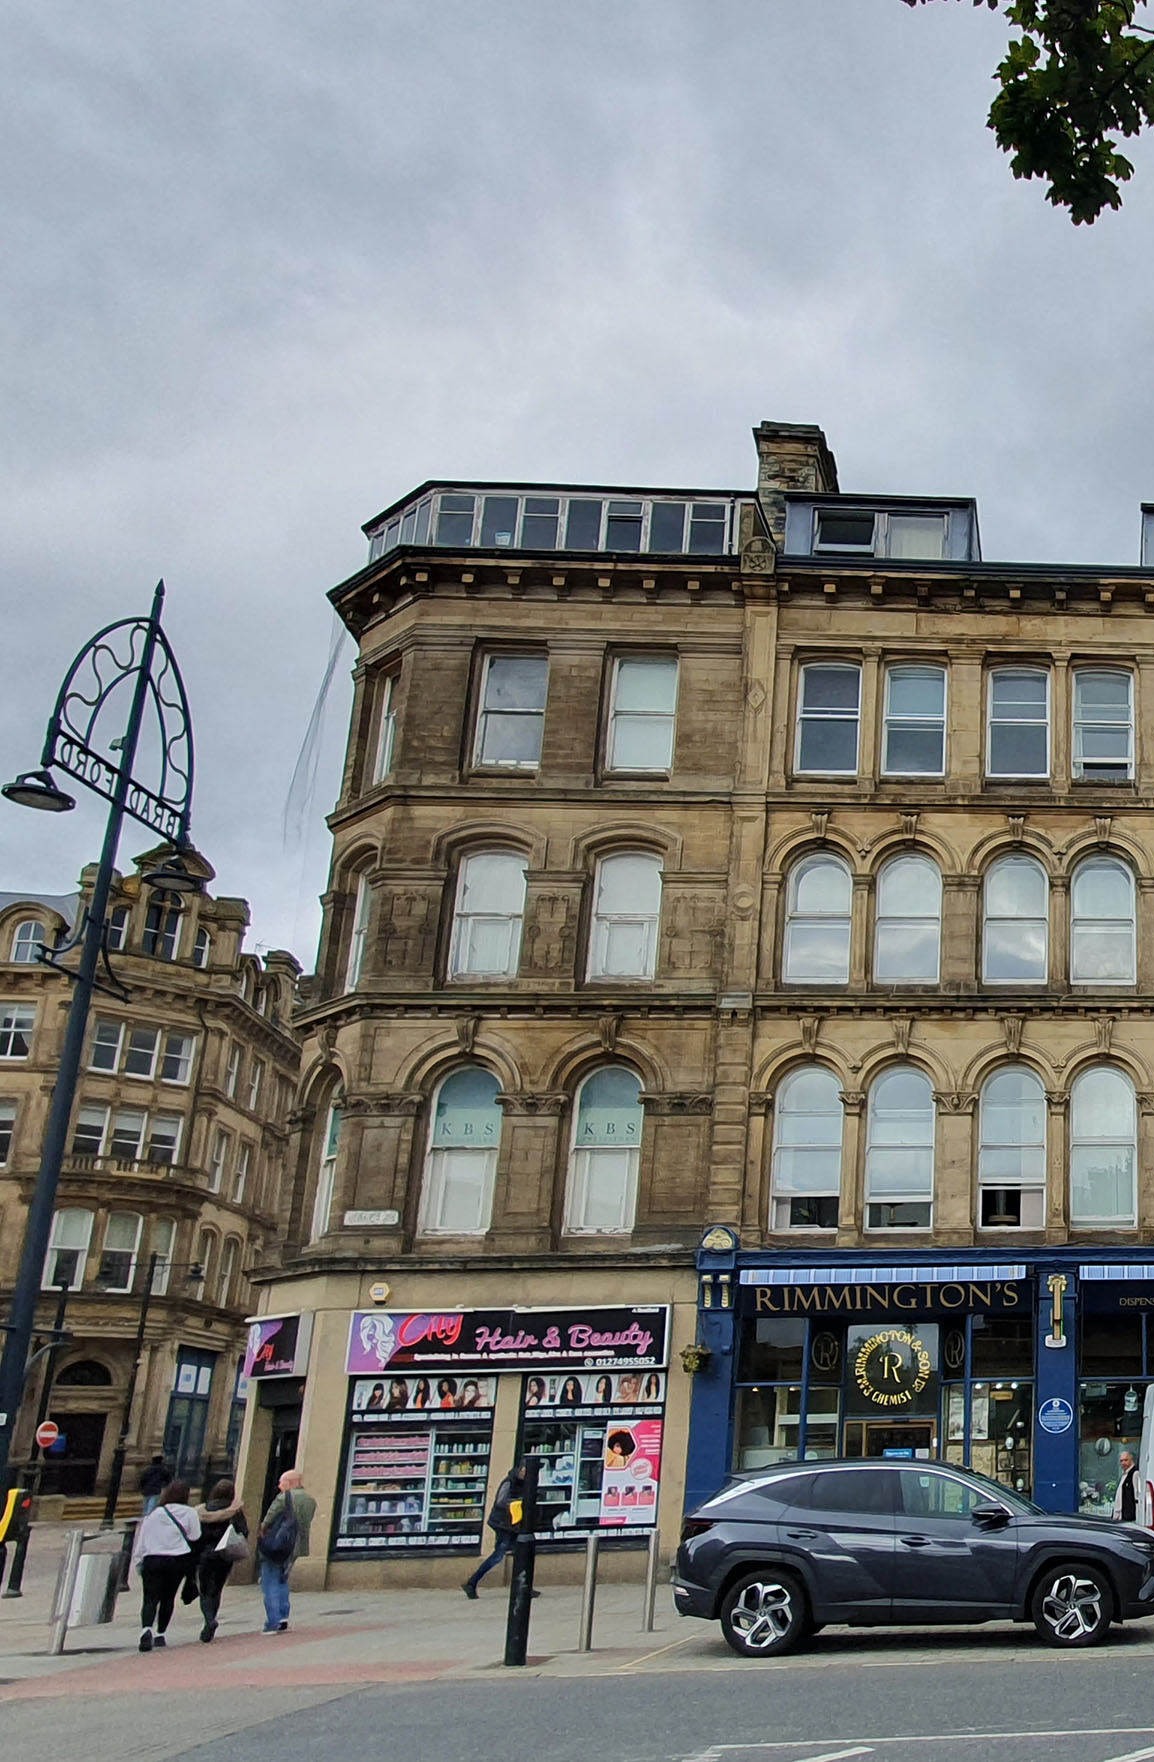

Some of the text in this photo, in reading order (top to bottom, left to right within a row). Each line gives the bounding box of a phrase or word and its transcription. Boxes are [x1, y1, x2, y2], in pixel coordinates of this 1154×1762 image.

[754, 1281, 1019, 1312] RIMMINGTON'S
[398, 1314, 464, 1347] City
[475, 1321, 653, 1355] Hair & Beauty
[595, 1356, 656, 1366] 01274955052
[879, 1352, 903, 1383] R
[918, 1351, 931, 1379] SON
[871, 1390, 912, 1406] CHEMIST
